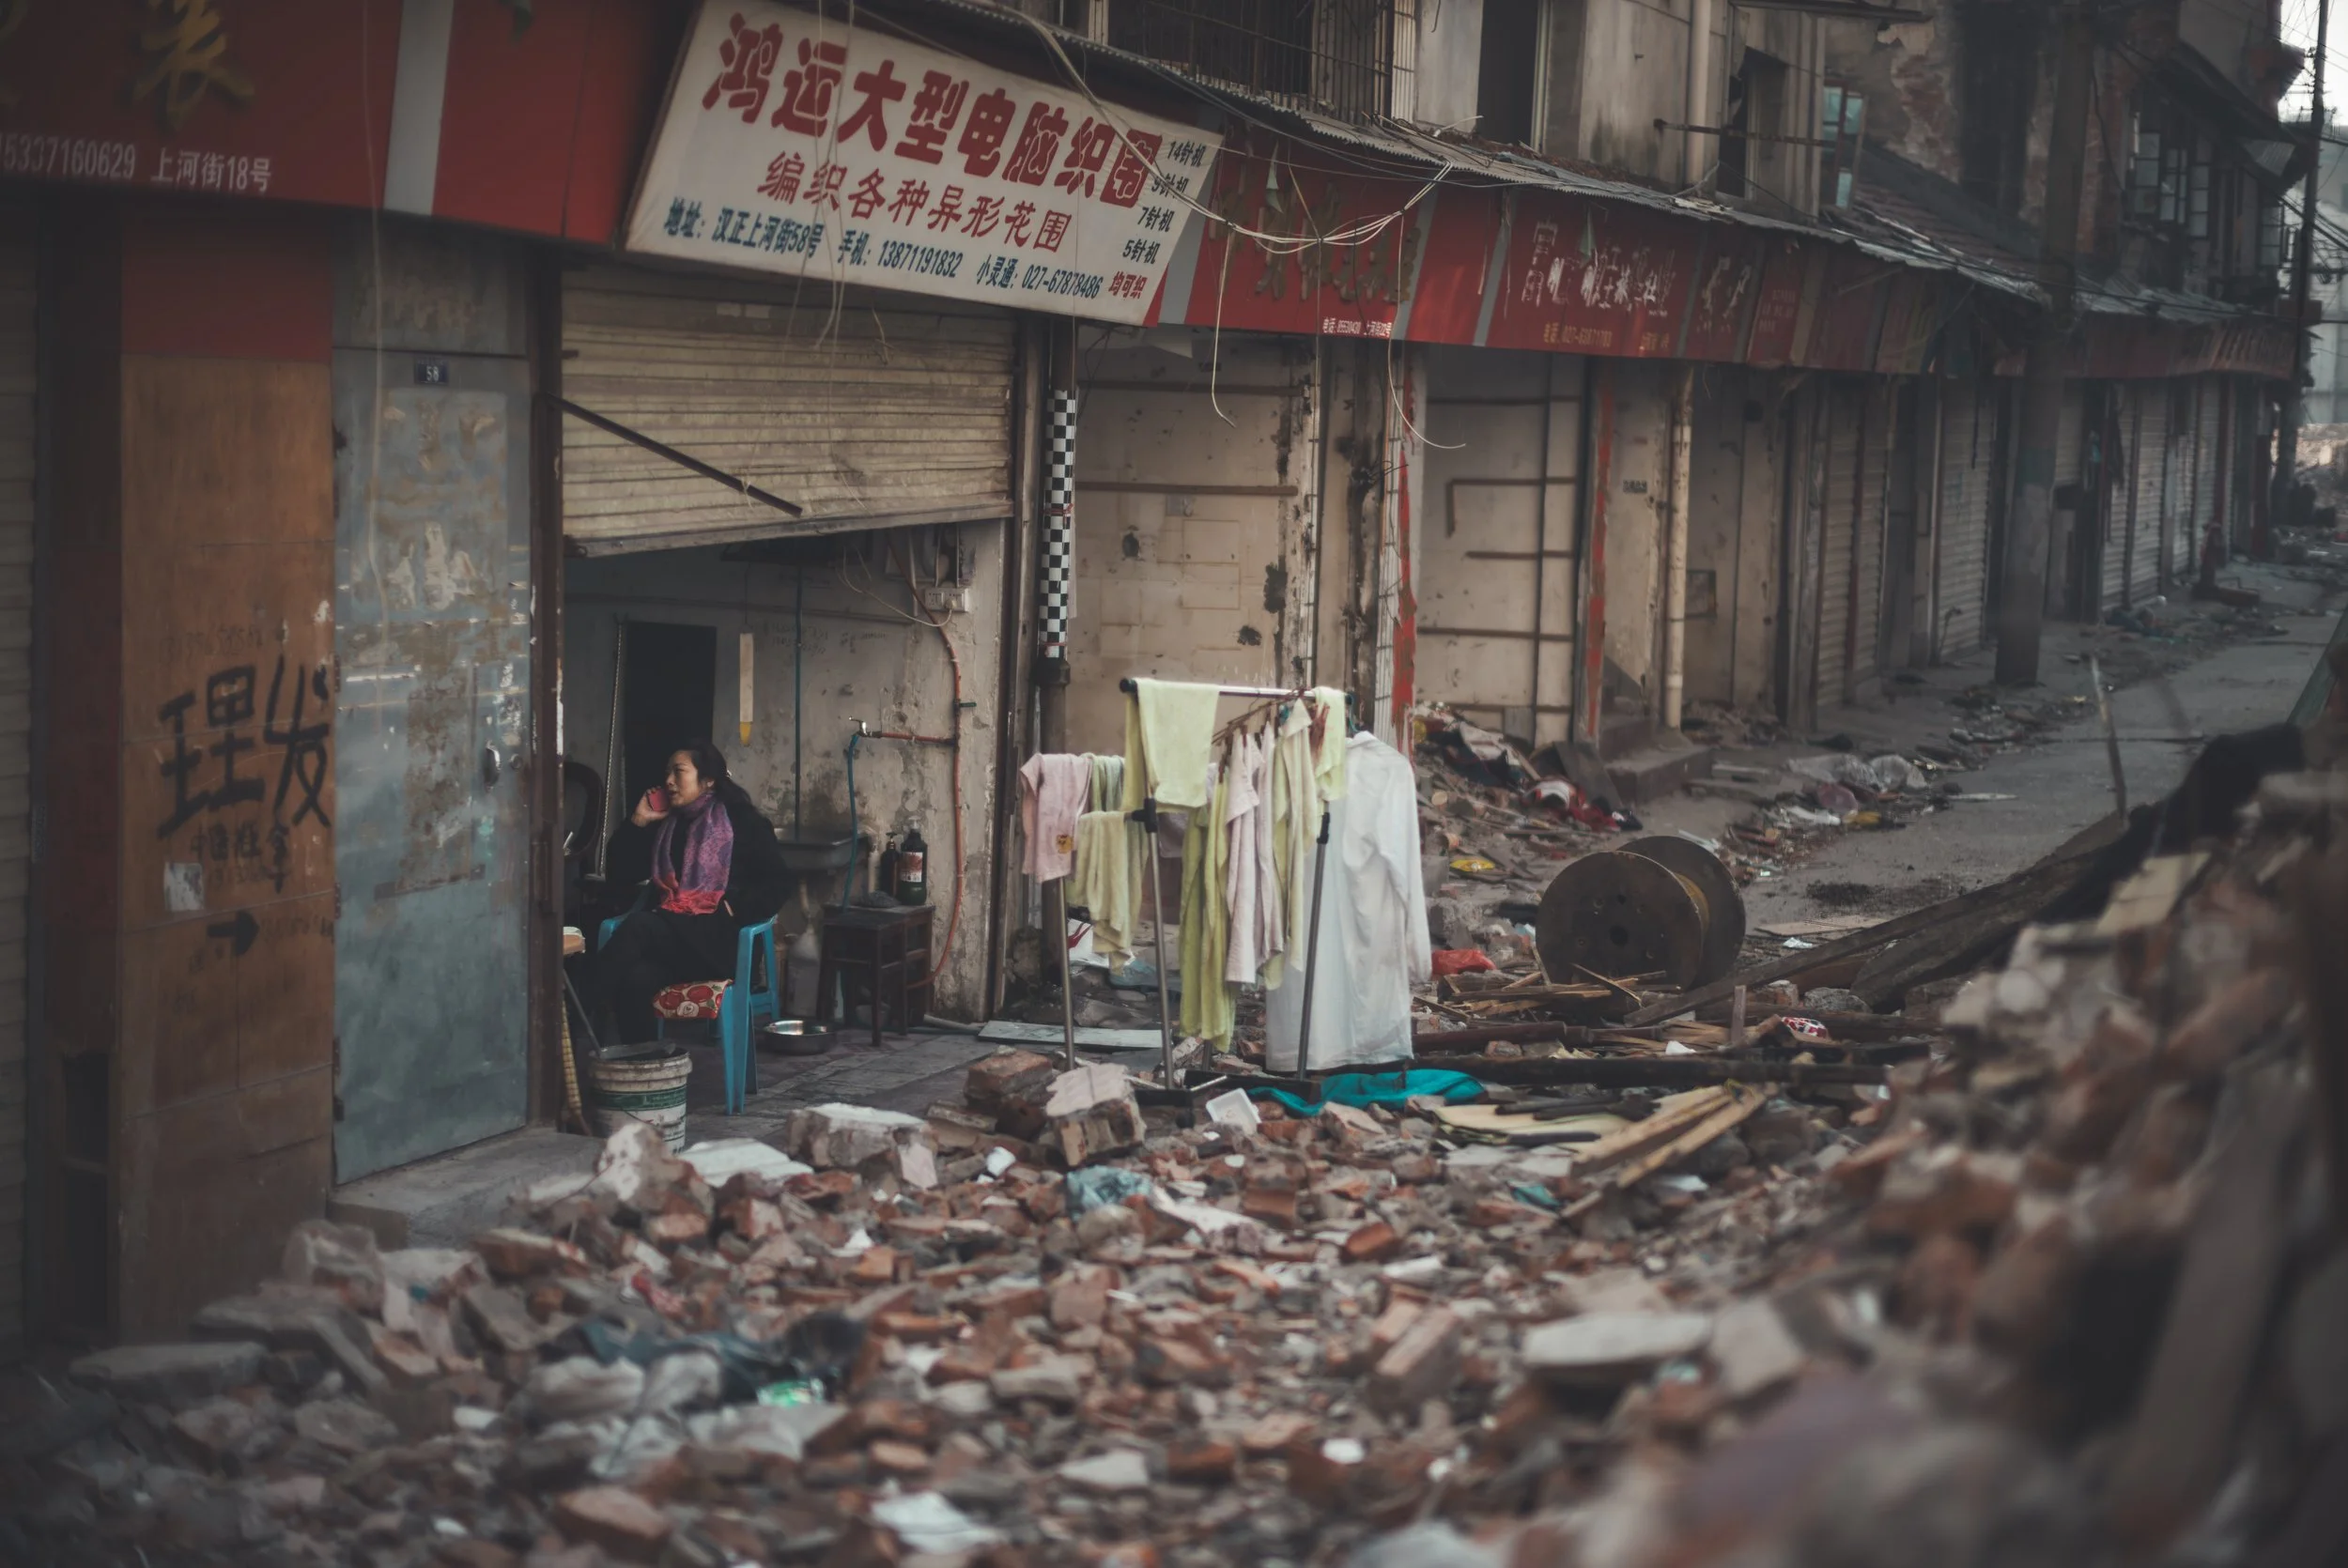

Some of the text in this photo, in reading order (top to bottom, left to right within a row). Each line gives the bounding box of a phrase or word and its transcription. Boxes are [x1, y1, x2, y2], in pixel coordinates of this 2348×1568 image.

[702, 11, 1163, 208] 鸿运大型电脑织围
[0, 132, 271, 193] 5337160629 上河街18号
[1166, 139, 1207, 167] 14针机
[1151, 173, 1189, 198] 9针机
[757, 150, 1072, 253] 编织各种异形花围
[1137, 206, 1174, 232] 7针机
[1122, 238, 1160, 264] 5针机
[1108, 270, 1148, 300] 均可织
[157, 654, 332, 838] 理发
